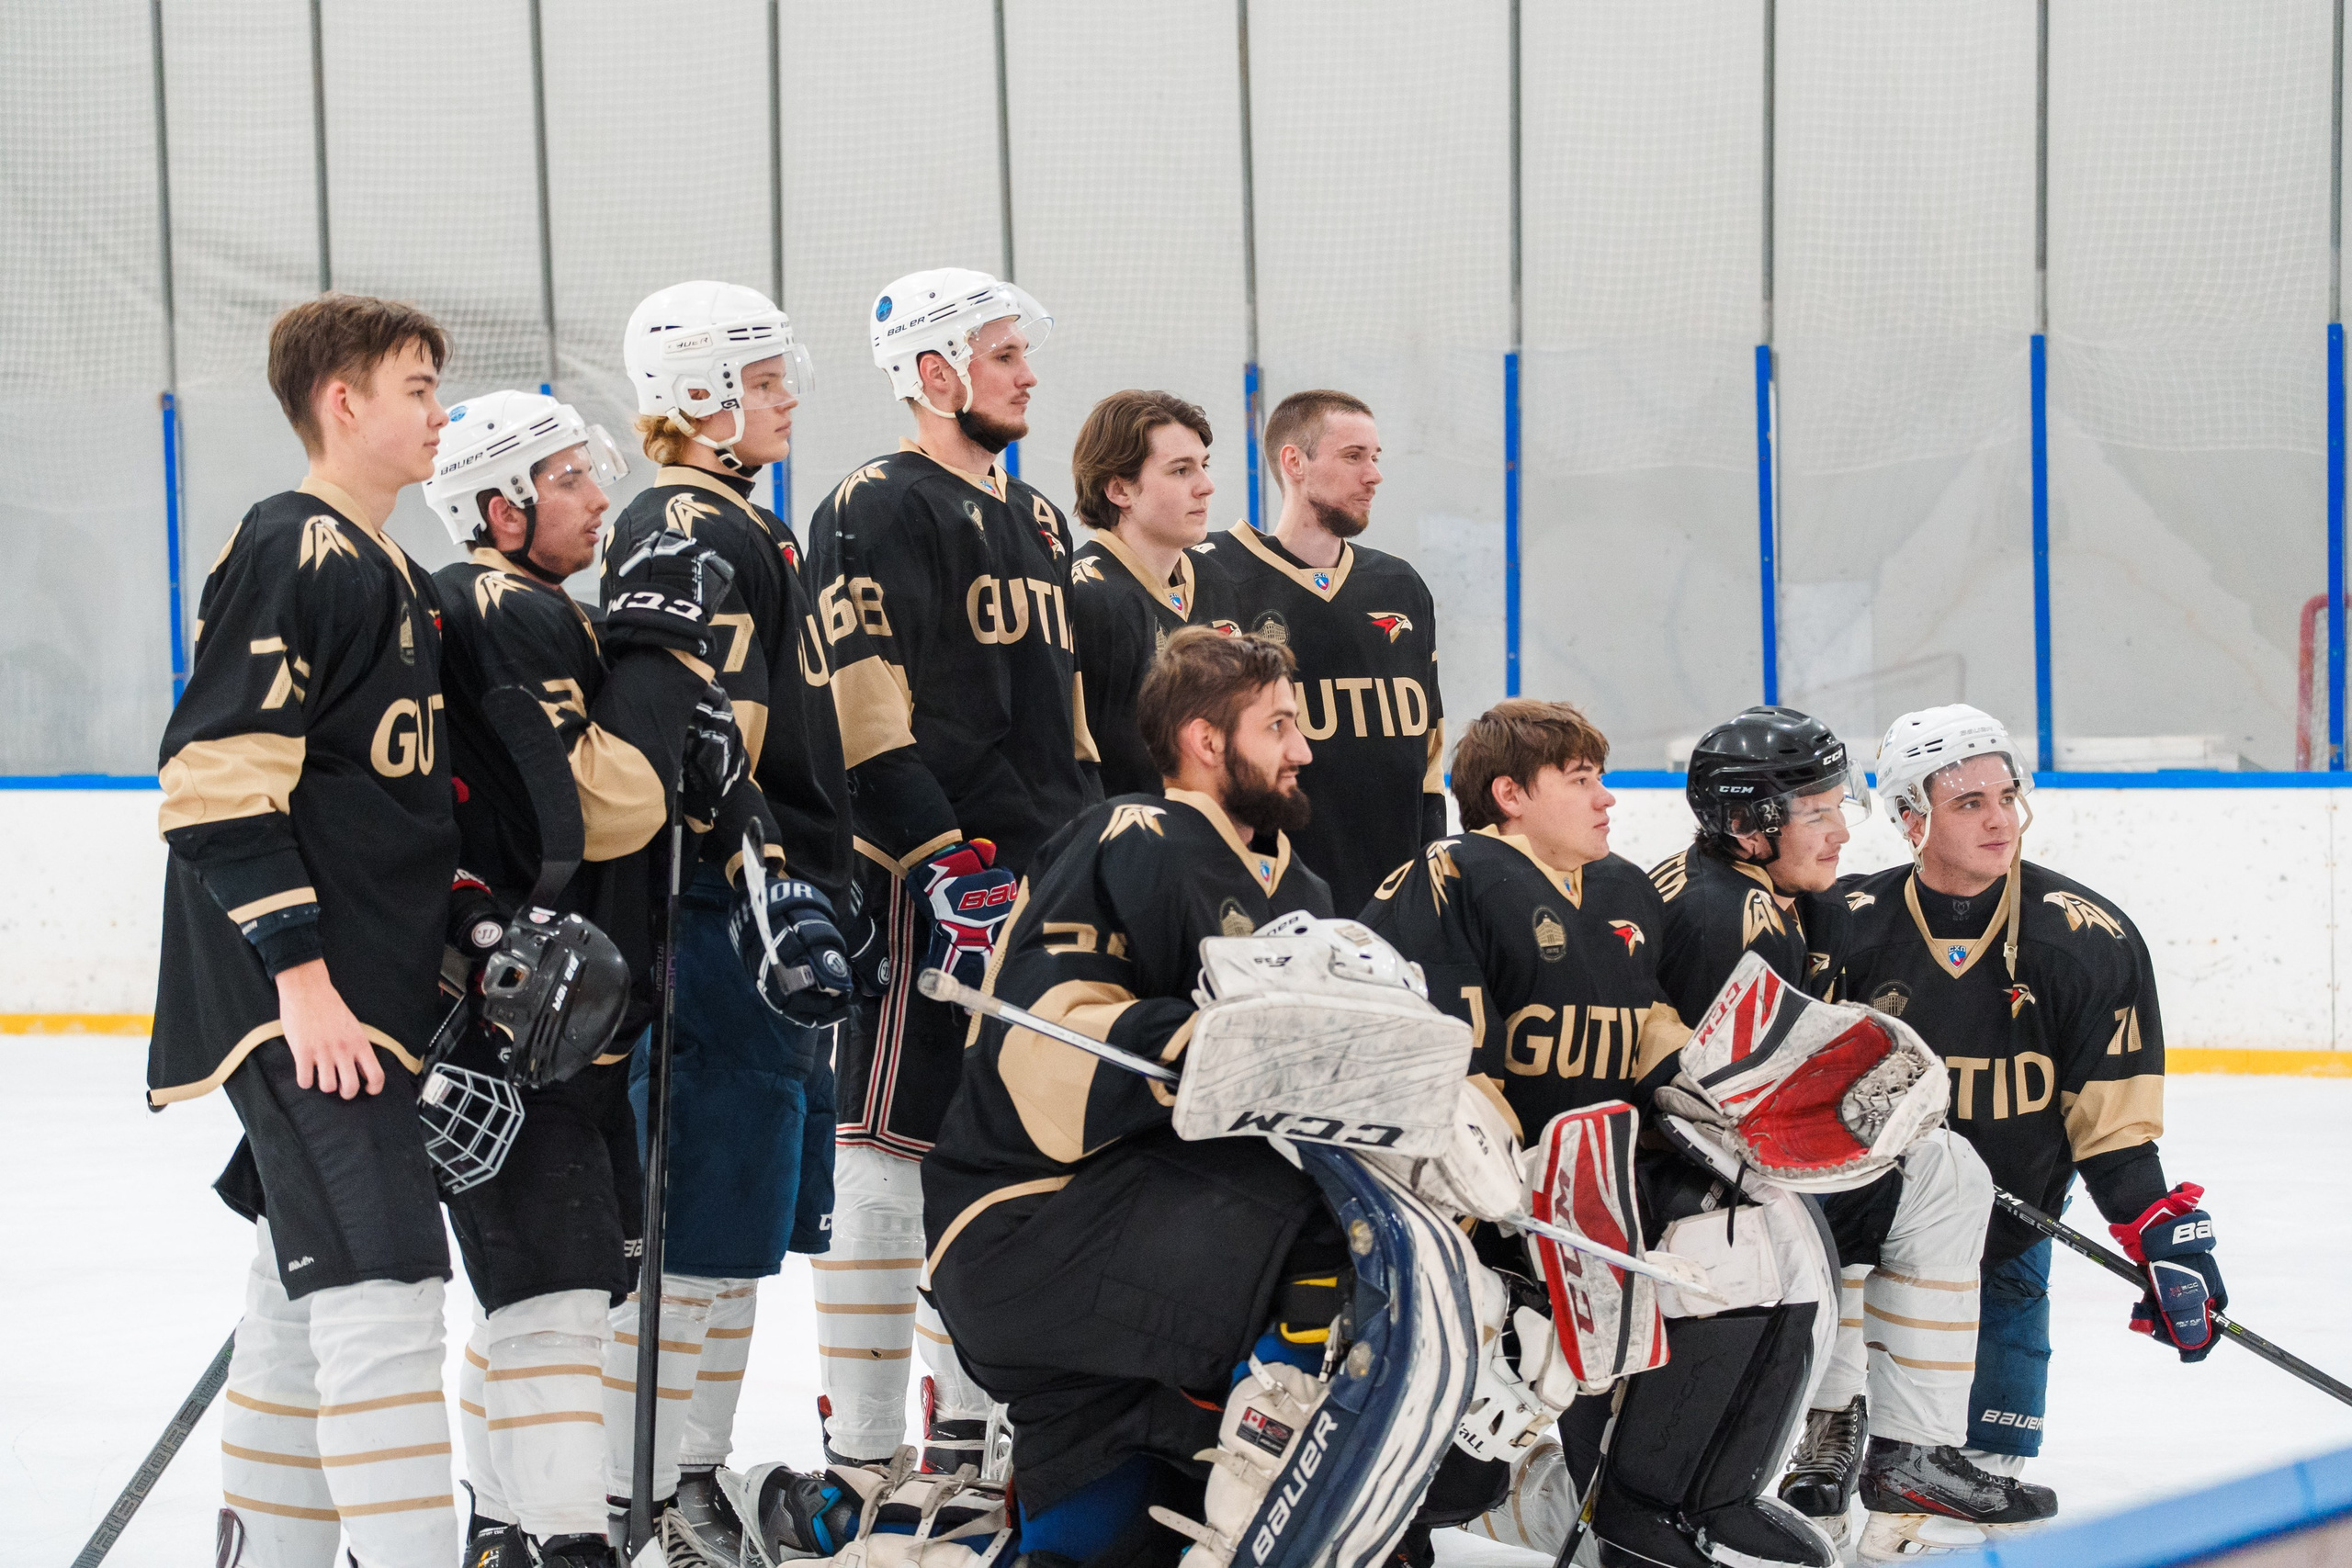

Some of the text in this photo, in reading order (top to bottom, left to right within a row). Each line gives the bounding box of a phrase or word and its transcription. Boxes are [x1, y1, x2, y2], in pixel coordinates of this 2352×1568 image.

[440, 452, 483, 476] BAUER
[819, 573, 893, 647] 68
[967, 574, 1075, 655] GUTI
[370, 694, 445, 778] GU
[1294, 676, 1429, 741] UTID
[1718, 785, 1755, 794] CCM
[1822, 748, 1844, 766] CCM
[1698, 981, 1743, 1047] CCM
[2107, 1005, 2143, 1055] 71
[1945, 1051, 2055, 1121] TID
[1227, 1111, 1405, 1148] CCM
[2172, 1219, 2213, 1246] BA
[1251, 1410, 1339, 1566] BAUER
